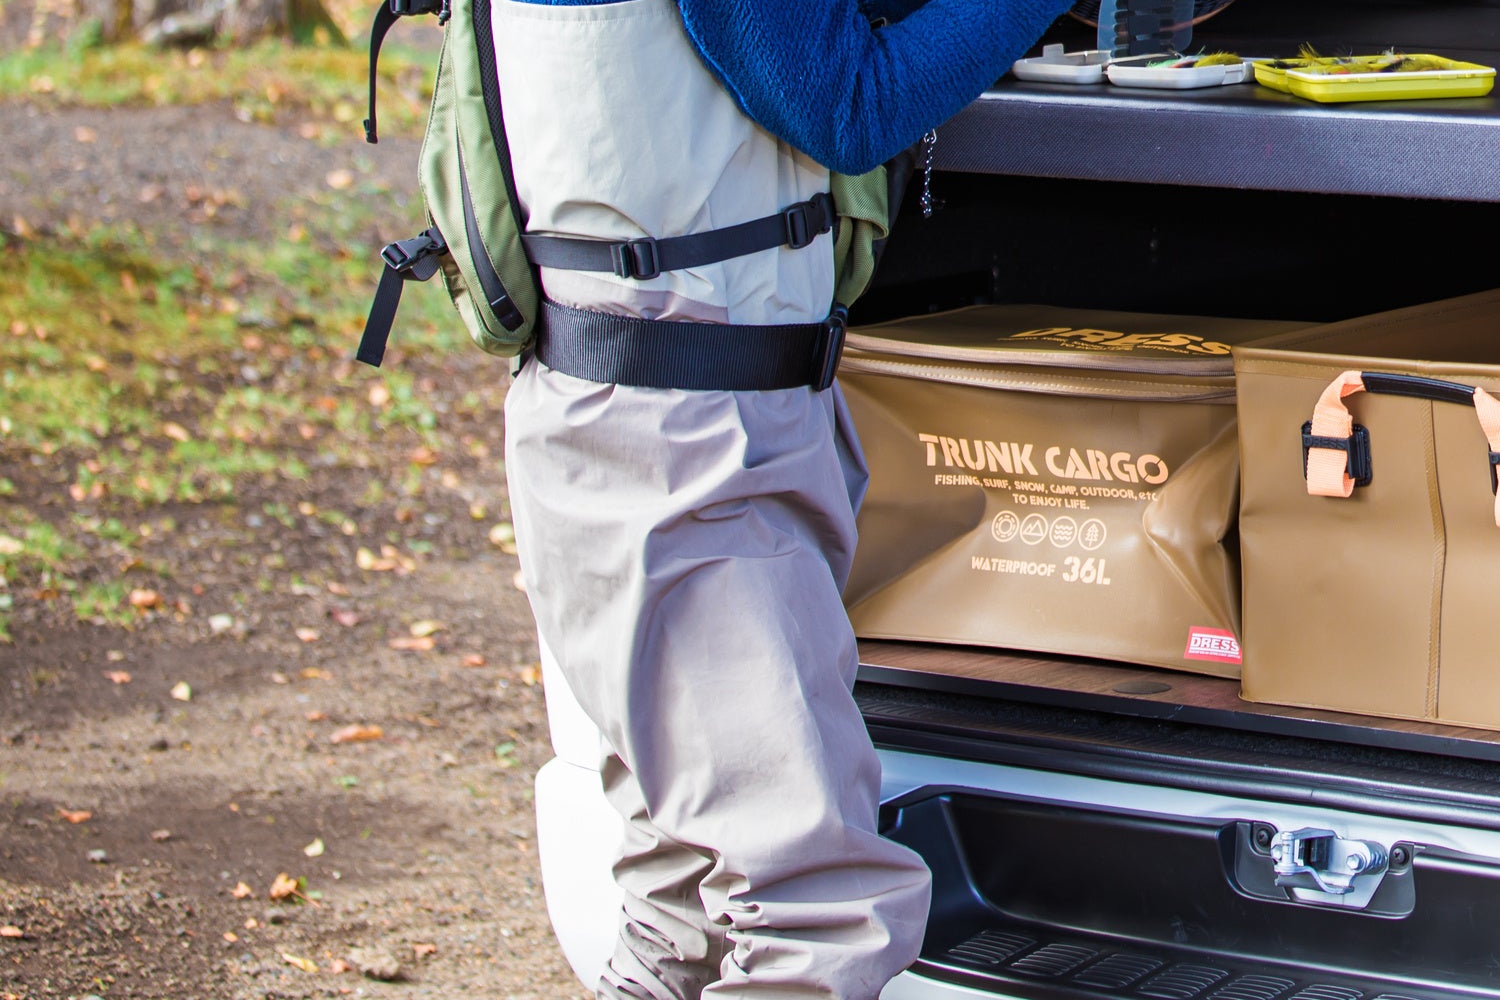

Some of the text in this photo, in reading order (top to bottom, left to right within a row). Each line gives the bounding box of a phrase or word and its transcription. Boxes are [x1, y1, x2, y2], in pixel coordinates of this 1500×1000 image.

[1010, 327, 1232, 355] DRESS
[919, 433, 1169, 485] TRUNK CARGO
[934, 474, 983, 487] FISHING,
[983, 478, 1011, 490] SURF,
[1014, 481, 1048, 494] SNOW,
[1050, 484, 1079, 496] CAMP,
[1080, 486, 1138, 500] OUTDOOR,
[1012, 493, 1090, 510] TO ENJOY LIFE.
[971, 556, 1111, 585] WATERPROOF 36L
[1190, 636, 1239, 652] DRESS
